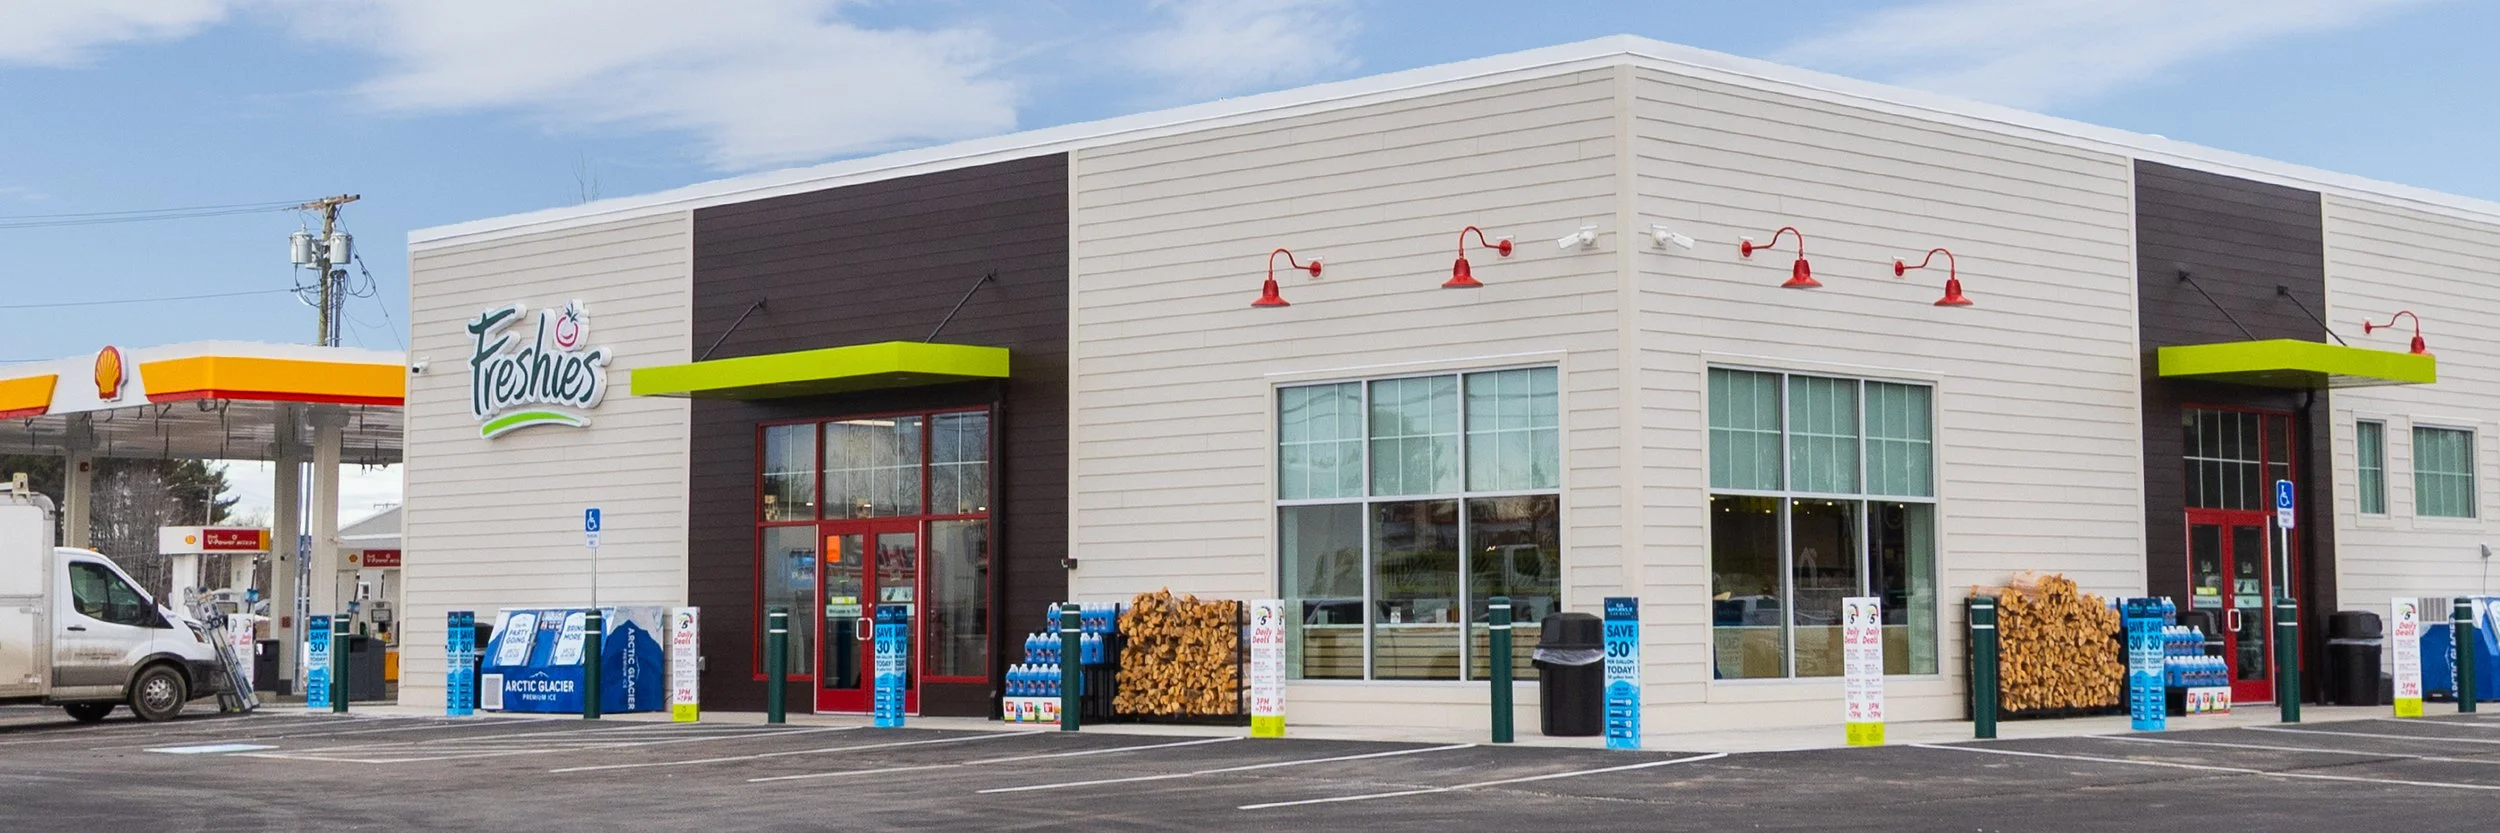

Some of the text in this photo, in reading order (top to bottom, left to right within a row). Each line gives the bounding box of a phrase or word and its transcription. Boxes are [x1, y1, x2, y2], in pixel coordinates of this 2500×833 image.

[467, 308, 601, 415] Freshies
[2399, 622, 2417, 630] Daily
[677, 631, 693, 640] Daily
[876, 627, 893, 638] SAVE
[1255, 628, 1272, 637] Daily
[1606, 624, 1634, 638] SAVE
[310, 632, 328, 640] SAVE
[1252, 635, 1269, 643] Deals
[674, 638, 691, 646] Deals
[627, 627, 636, 710] ARCTIC GLACIER
[1607, 665, 1636, 674] TODAY!
[505, 680, 575, 693] ARCTIC GLACIER
